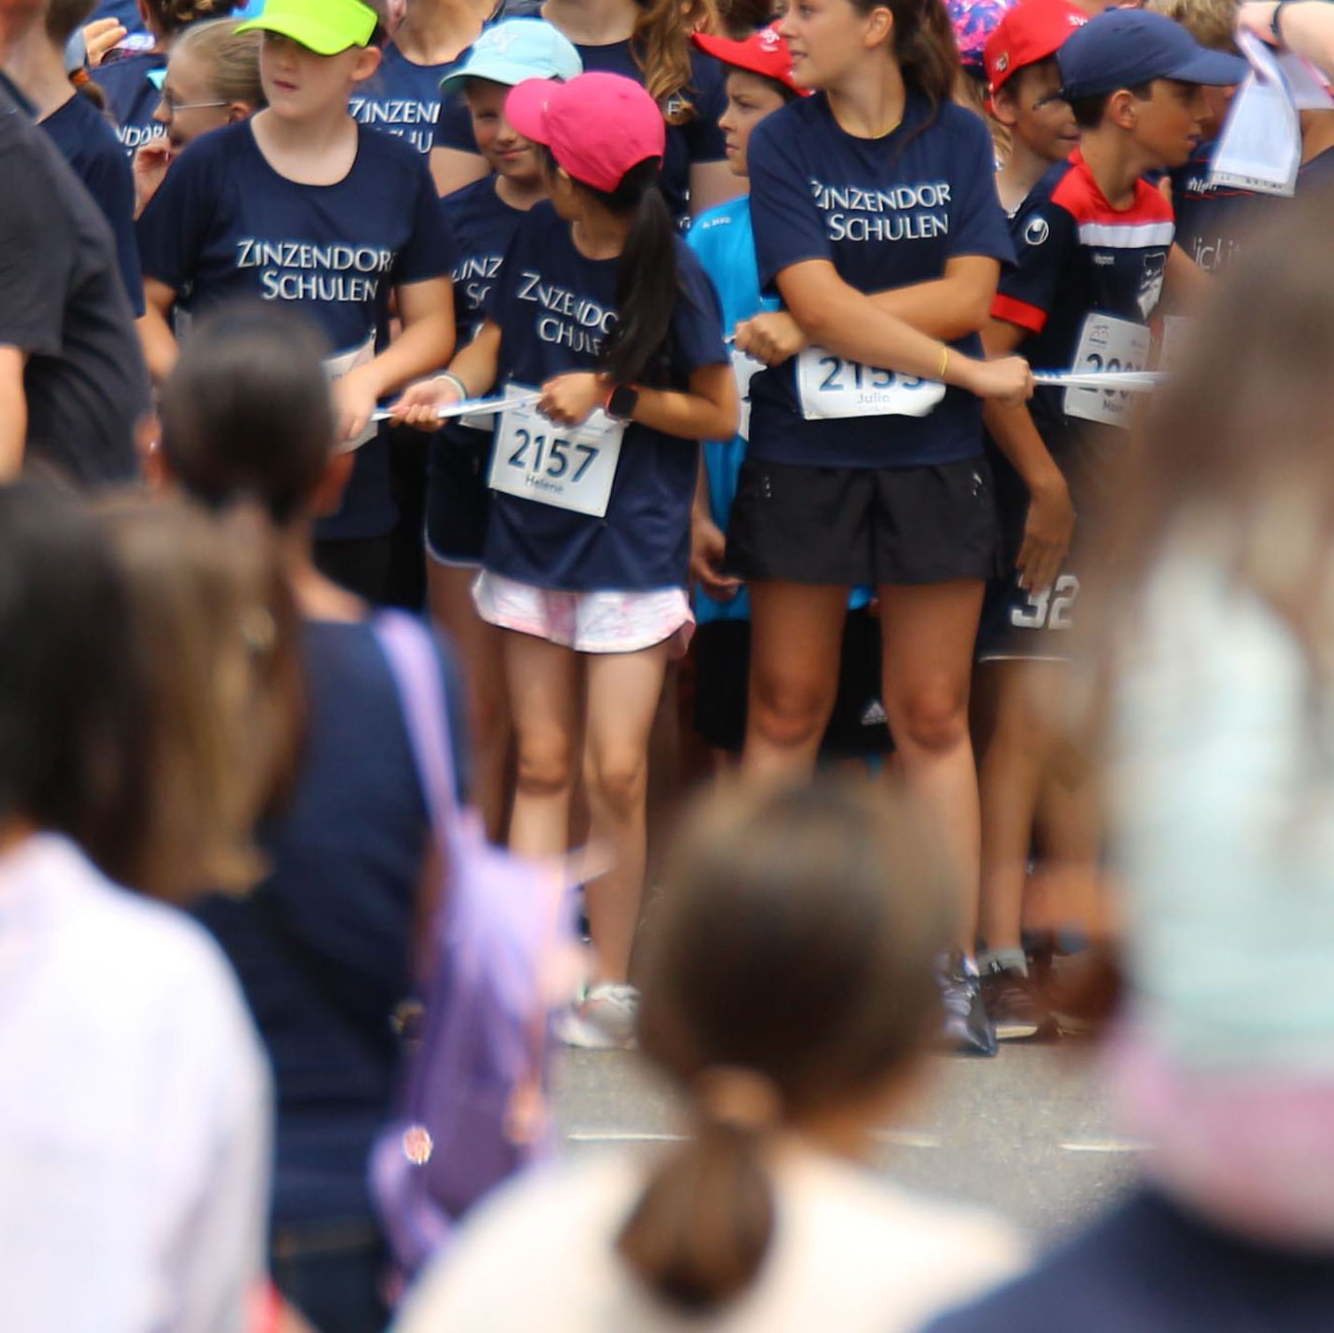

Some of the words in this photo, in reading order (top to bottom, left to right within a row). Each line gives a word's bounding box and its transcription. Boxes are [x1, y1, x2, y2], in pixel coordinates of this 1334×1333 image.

[828, 213, 948, 242] SCHULEN
[261, 270, 378, 302] SCHULEN
[508, 428, 601, 484] 2157
[1011, 574, 1080, 629] 32
